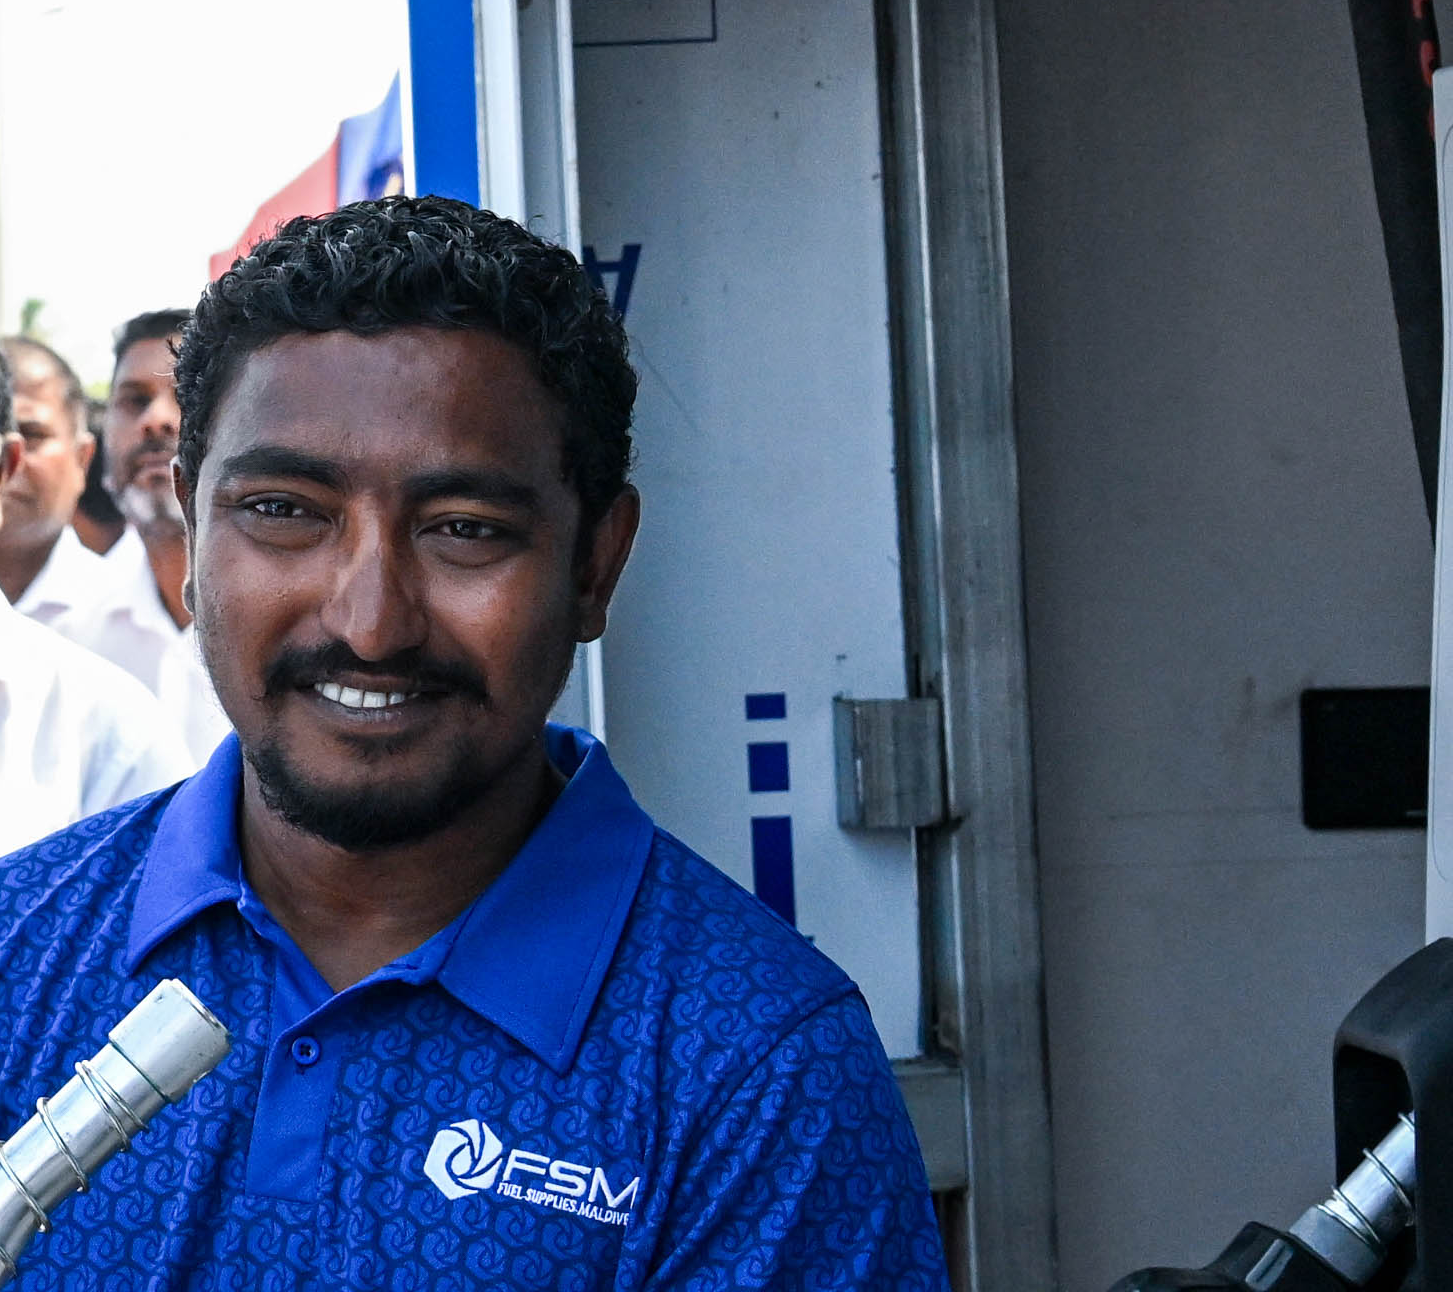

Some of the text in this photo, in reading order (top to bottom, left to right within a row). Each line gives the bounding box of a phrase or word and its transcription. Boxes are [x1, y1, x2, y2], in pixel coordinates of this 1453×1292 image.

[496, 1181, 630, 1227] FUEL SUPPLIES MALDIVE
[502, 1148, 641, 1210] FSM
